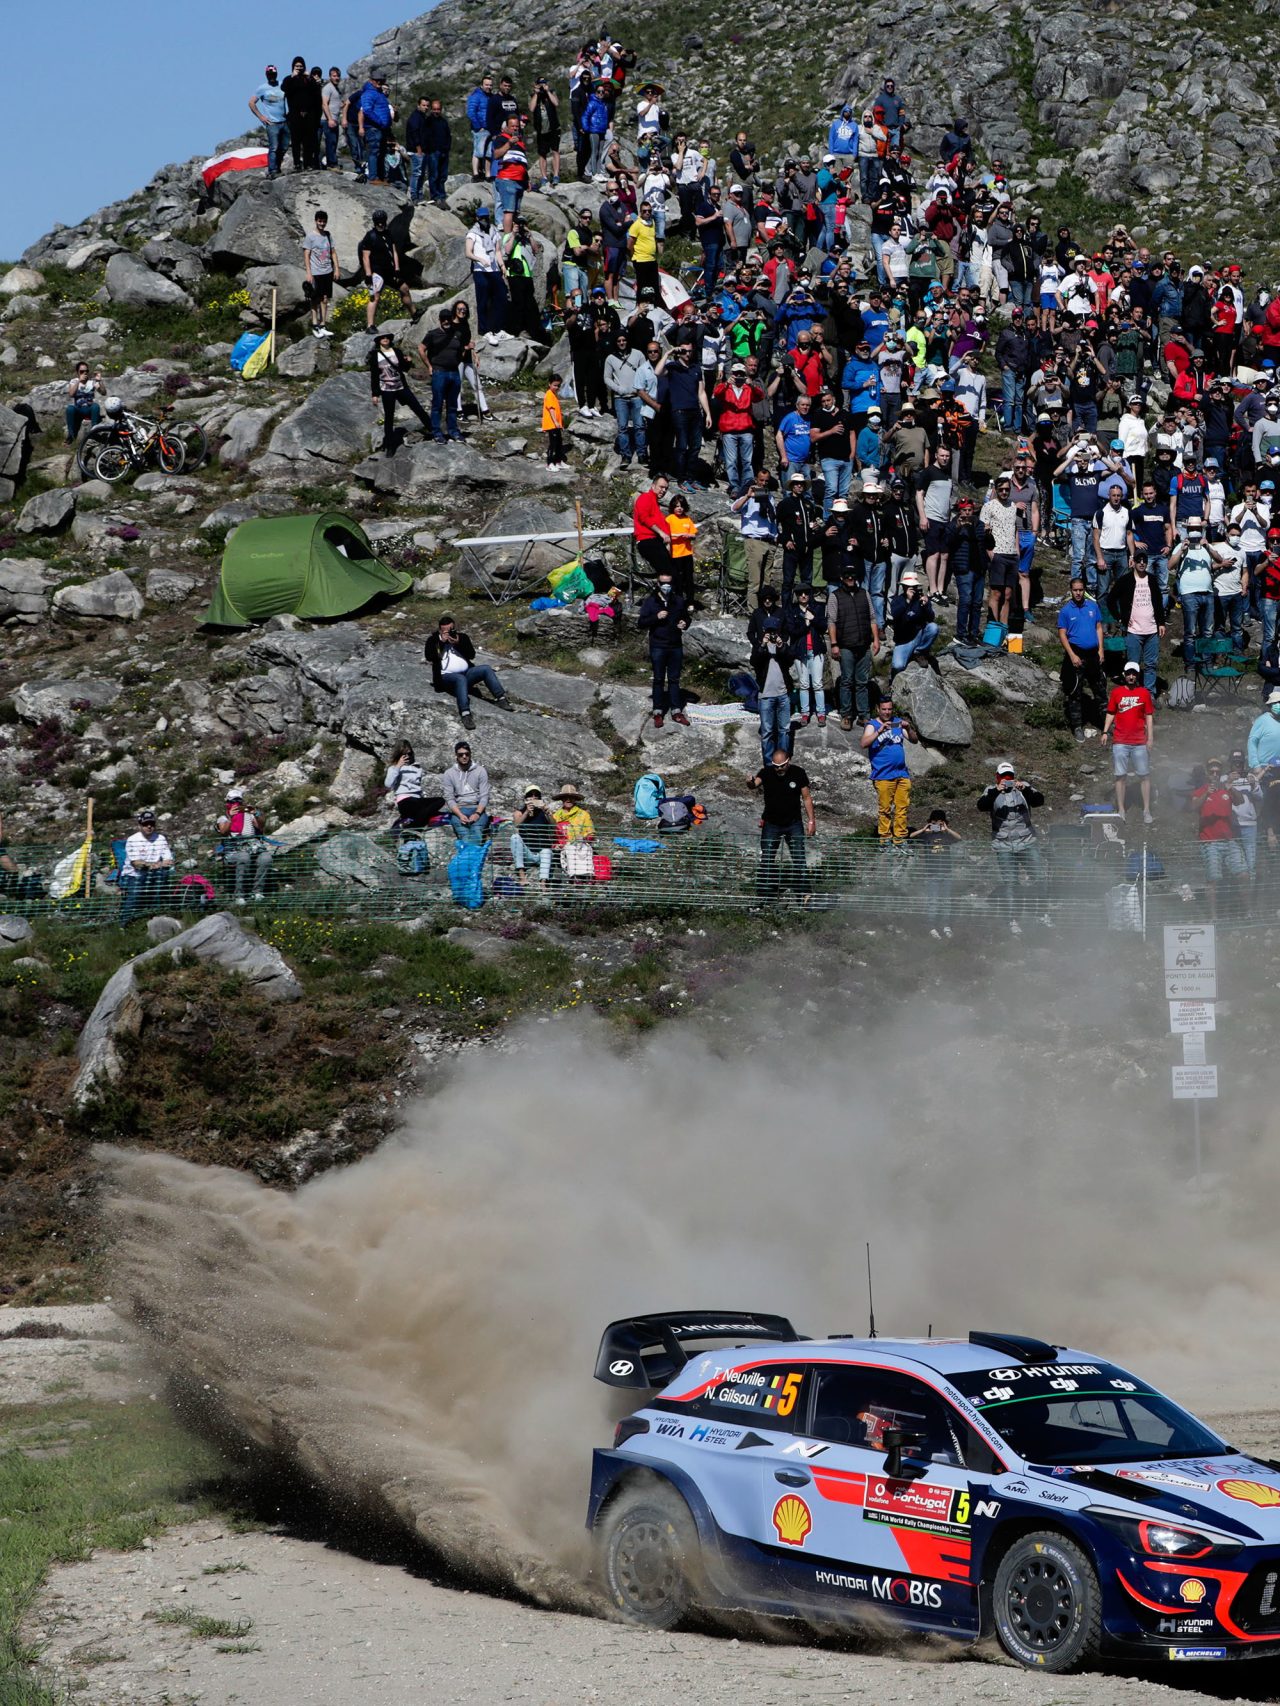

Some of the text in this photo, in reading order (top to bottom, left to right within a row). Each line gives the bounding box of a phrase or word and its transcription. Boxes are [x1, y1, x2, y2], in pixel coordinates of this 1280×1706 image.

[1182, 485, 1202, 494] MIUT
[682, 1324, 769, 1332] HYUNDAI
[712, 1366, 766, 1387] T. Neuville
[1022, 1365, 1103, 1379] HYUNDAI
[704, 1386, 758, 1406] N. Gilsoul
[776, 1372, 803, 1416] 5
[943, 1386, 1004, 1451] motorsport.hyundai.com
[703, 1435, 727, 1445] STEEL
[709, 1427, 743, 1438] HYUNDAI
[1175, 1463, 1278, 1478] MOBIS
[868, 1496, 890, 1505] vodafone
[893, 1491, 947, 1509] Portugal
[1038, 1490, 1069, 1503] Sabelt
[956, 1492, 970, 1524] 5
[890, 1516, 904, 1524] World
[904, 1518, 917, 1528] Rally
[917, 1520, 950, 1533] Championship
[1048, 1548, 1078, 1582] MICHELIN
[815, 1571, 868, 1591] HYUNDAI
[871, 1575, 942, 1609] MOBIS
[1176, 1625, 1203, 1633] STEEL
[1177, 1619, 1213, 1627] HYUNDAI
[1003, 1625, 1031, 1659] MICHELIN
